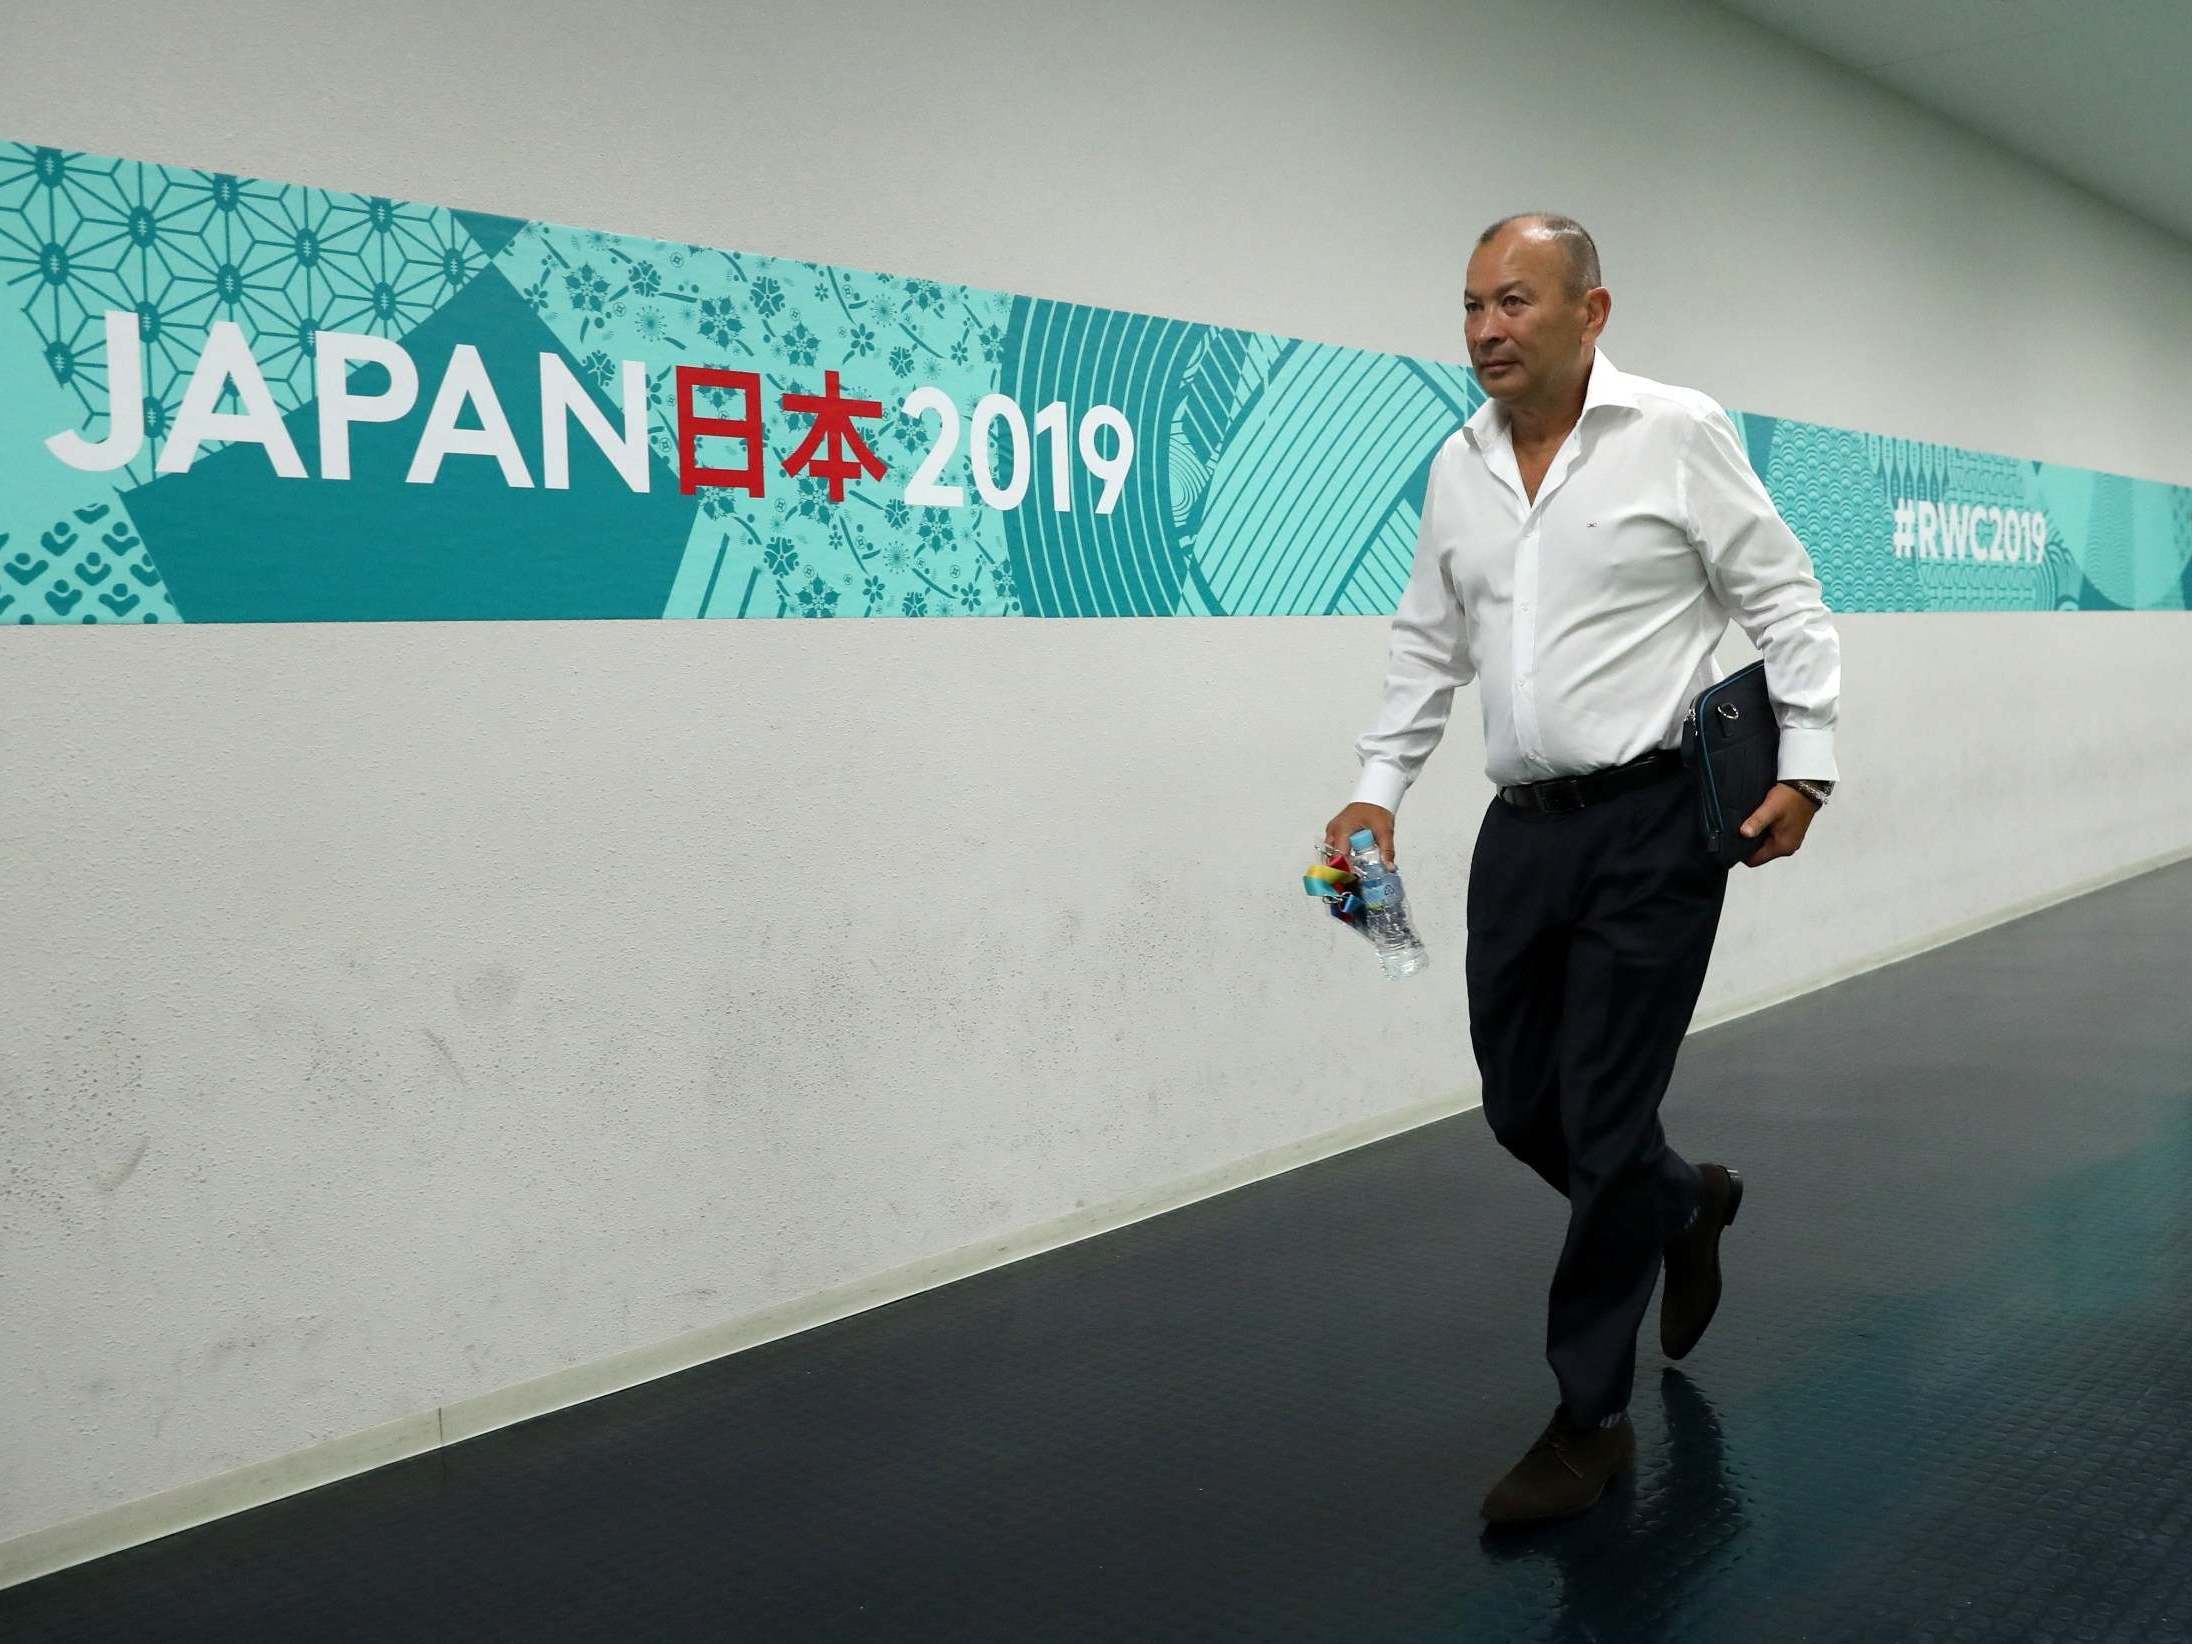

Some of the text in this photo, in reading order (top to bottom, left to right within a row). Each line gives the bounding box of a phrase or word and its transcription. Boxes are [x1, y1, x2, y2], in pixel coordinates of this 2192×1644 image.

[44, 309, 1135, 515] JAPAN 日本 2019
[1893, 498, 2047, 564] #RWC2019
